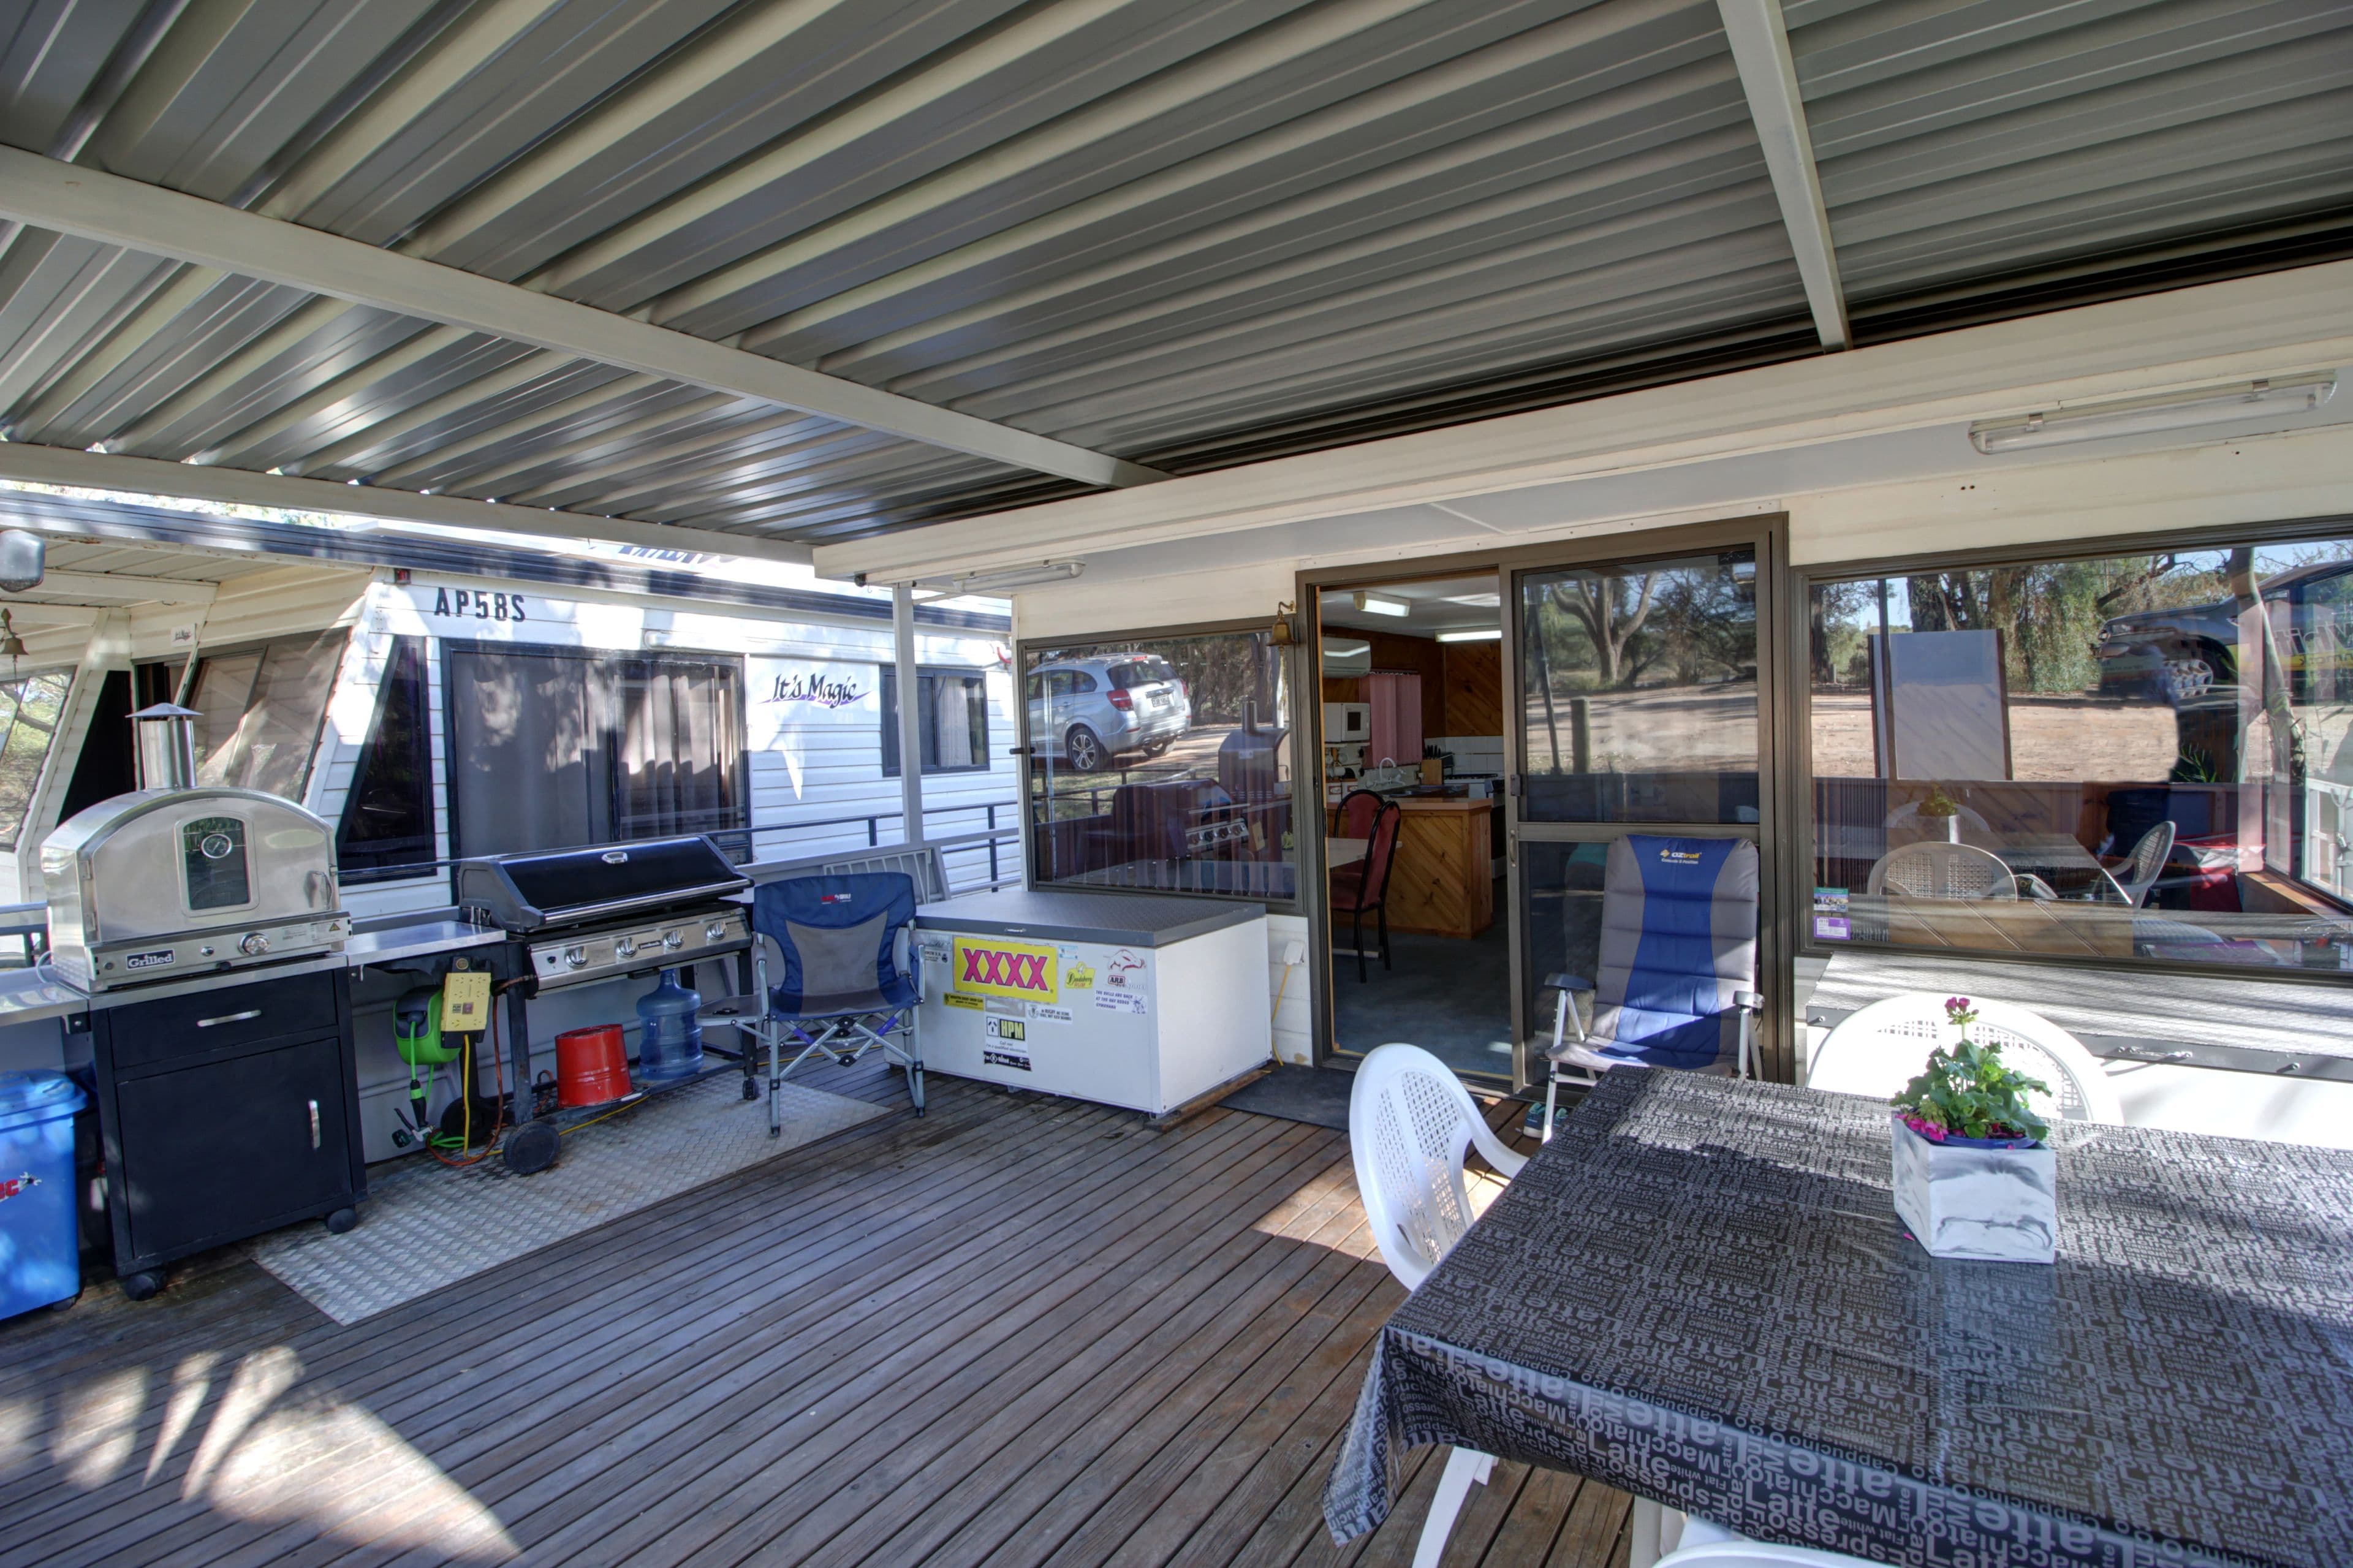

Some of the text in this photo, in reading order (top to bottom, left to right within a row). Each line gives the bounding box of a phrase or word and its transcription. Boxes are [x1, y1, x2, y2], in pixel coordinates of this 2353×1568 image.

[434, 587, 526, 622] AP58S
[773, 673, 857, 709] It's Magic
[128, 953, 172, 967] Grilled
[962, 949, 1048, 991] XXXX
[1001, 1020, 1024, 1040] HPM
[1456, 1373, 1566, 1425] Macchiato
[1485, 1356, 1591, 1417] Latte
[1589, 1429, 1670, 1477] Latte
[1590, 1417, 1719, 1475] Macchiato
[1627, 1401, 1748, 1464] Latte
[1671, 1464, 1726, 1490] Flat white
[1720, 1436, 1733, 1479] Latte
[1608, 1460, 1729, 1516] Espresso
[1746, 1478, 1840, 1531] Latte
[1748, 1465, 1896, 1529] Macchiato
[1789, 1447, 1927, 1518] Latte
[1841, 1517, 1904, 1546] Flat white
[1898, 1487, 1912, 1534] Latte
[1974, 1501, 2134, 1568] Latte
